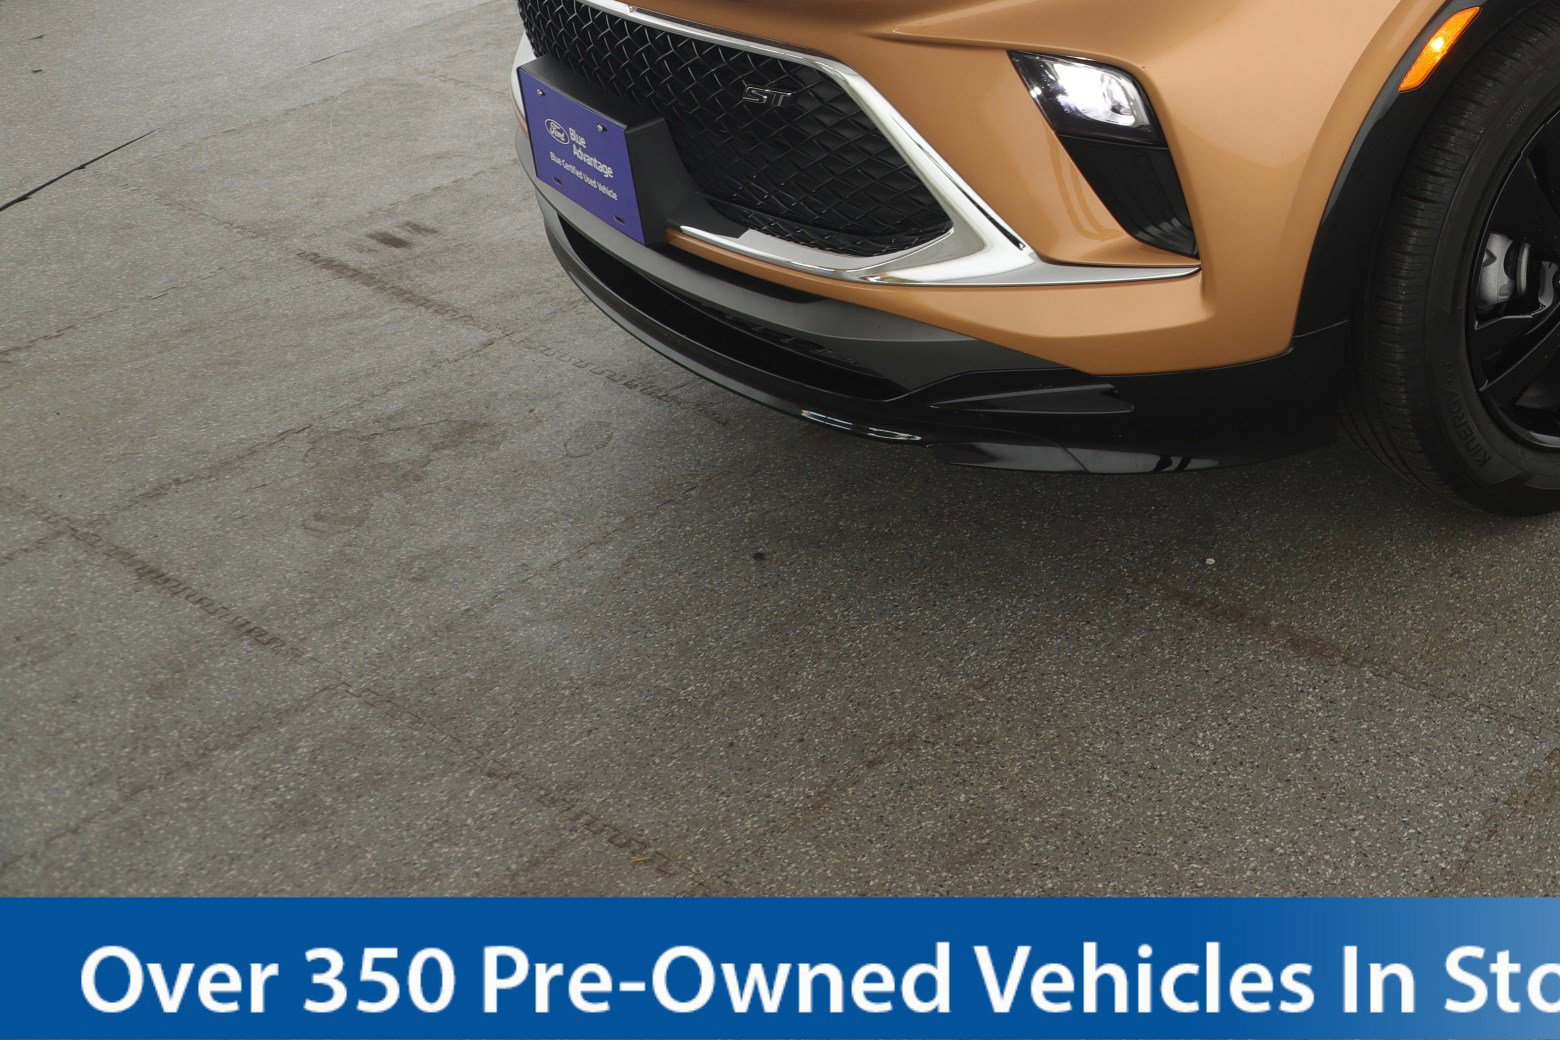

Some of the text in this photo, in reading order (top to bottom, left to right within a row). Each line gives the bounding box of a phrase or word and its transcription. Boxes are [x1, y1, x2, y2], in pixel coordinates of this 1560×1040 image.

[743, 86, 792, 107] ST
[568, 127, 587, 149] Blue
[572, 145, 614, 178] Advantage
[550, 151, 618, 201] Blue Certified Used Vehicle
